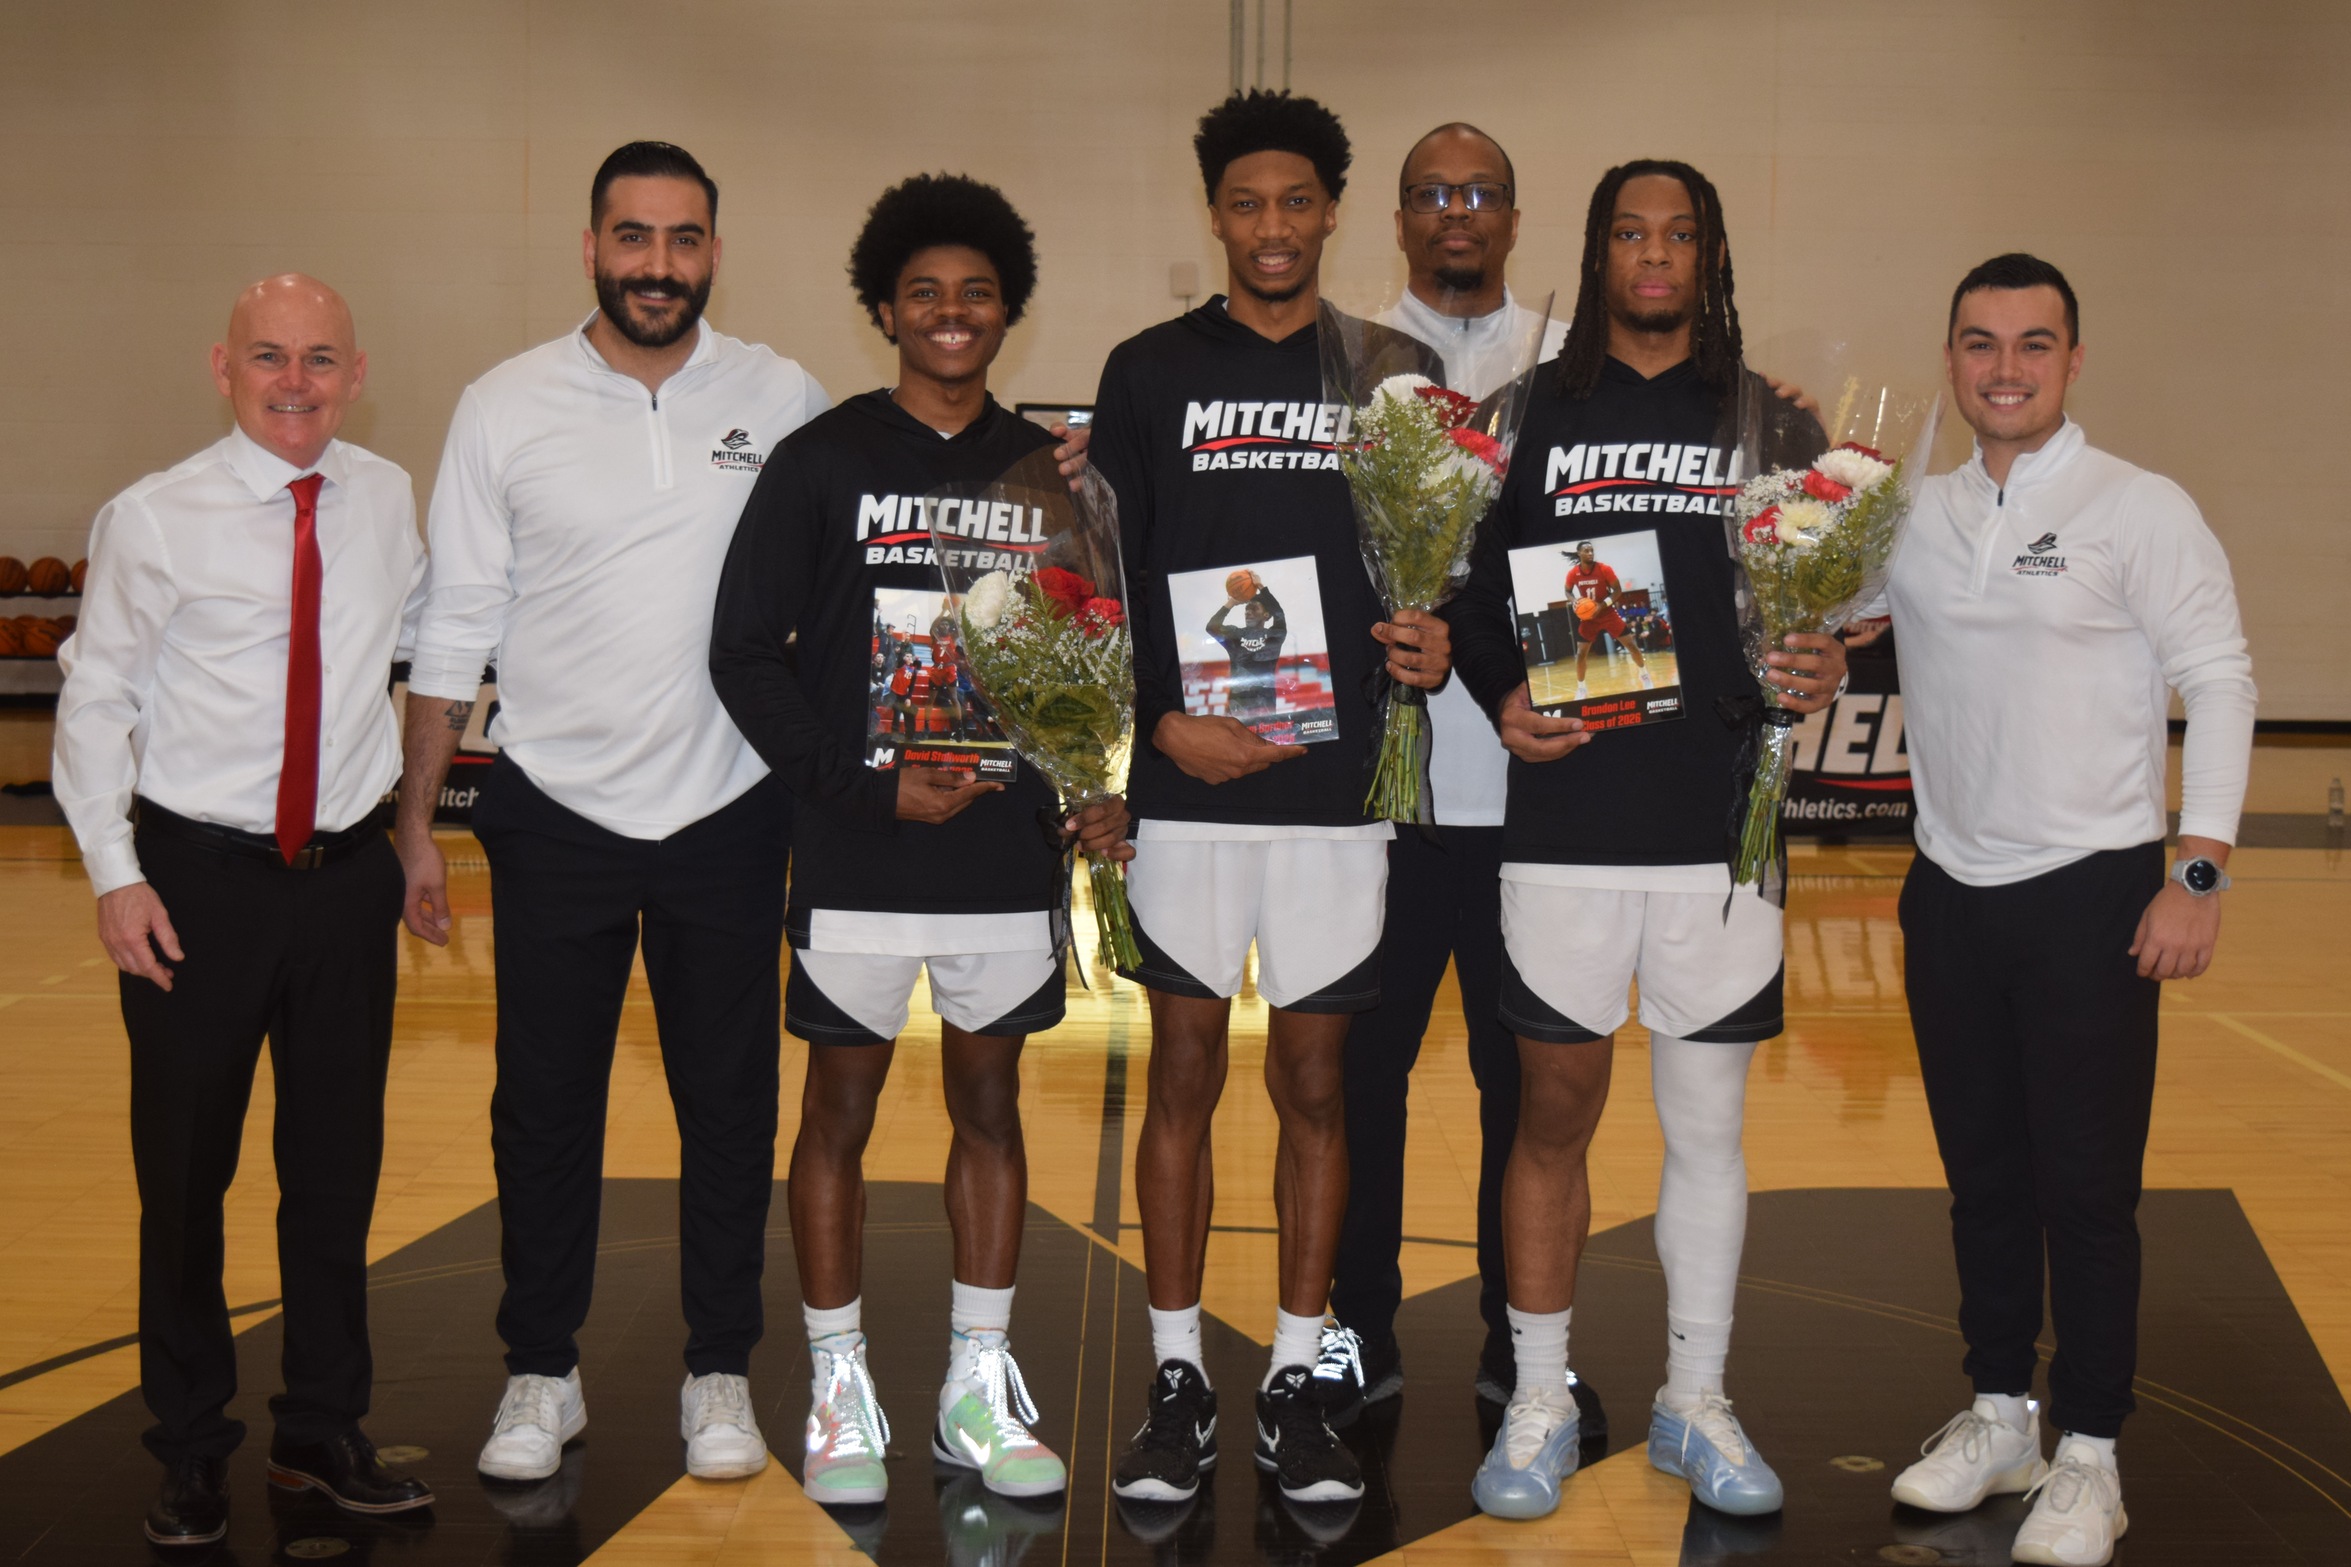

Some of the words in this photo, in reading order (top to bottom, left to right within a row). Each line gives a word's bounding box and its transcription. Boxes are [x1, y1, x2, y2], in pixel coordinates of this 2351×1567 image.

[1182, 401, 1354, 449] MITCHEL
[711, 450, 763, 464] MITCHELL
[1193, 452, 1341, 472] BASKETBA
[1555, 494, 1736, 517] BASKETBALL
[857, 494, 1048, 542] MITCHELL
[2012, 555, 2065, 568] MITCHELL
[1581, 703, 1618, 717] Brandon
[1620, 700, 1636, 711] Lee
[1646, 698, 1678, 710] MITCHELL
[1301, 719, 1332, 731] MITCHELL
[1607, 719, 1616, 728] of
[1620, 712, 1641, 726] 2026
[1792, 694, 1910, 774] HEL
[904, 749, 930, 761] David
[980, 758, 1012, 768] MITCHELL
[1784, 798, 1908, 820] hletics.com
